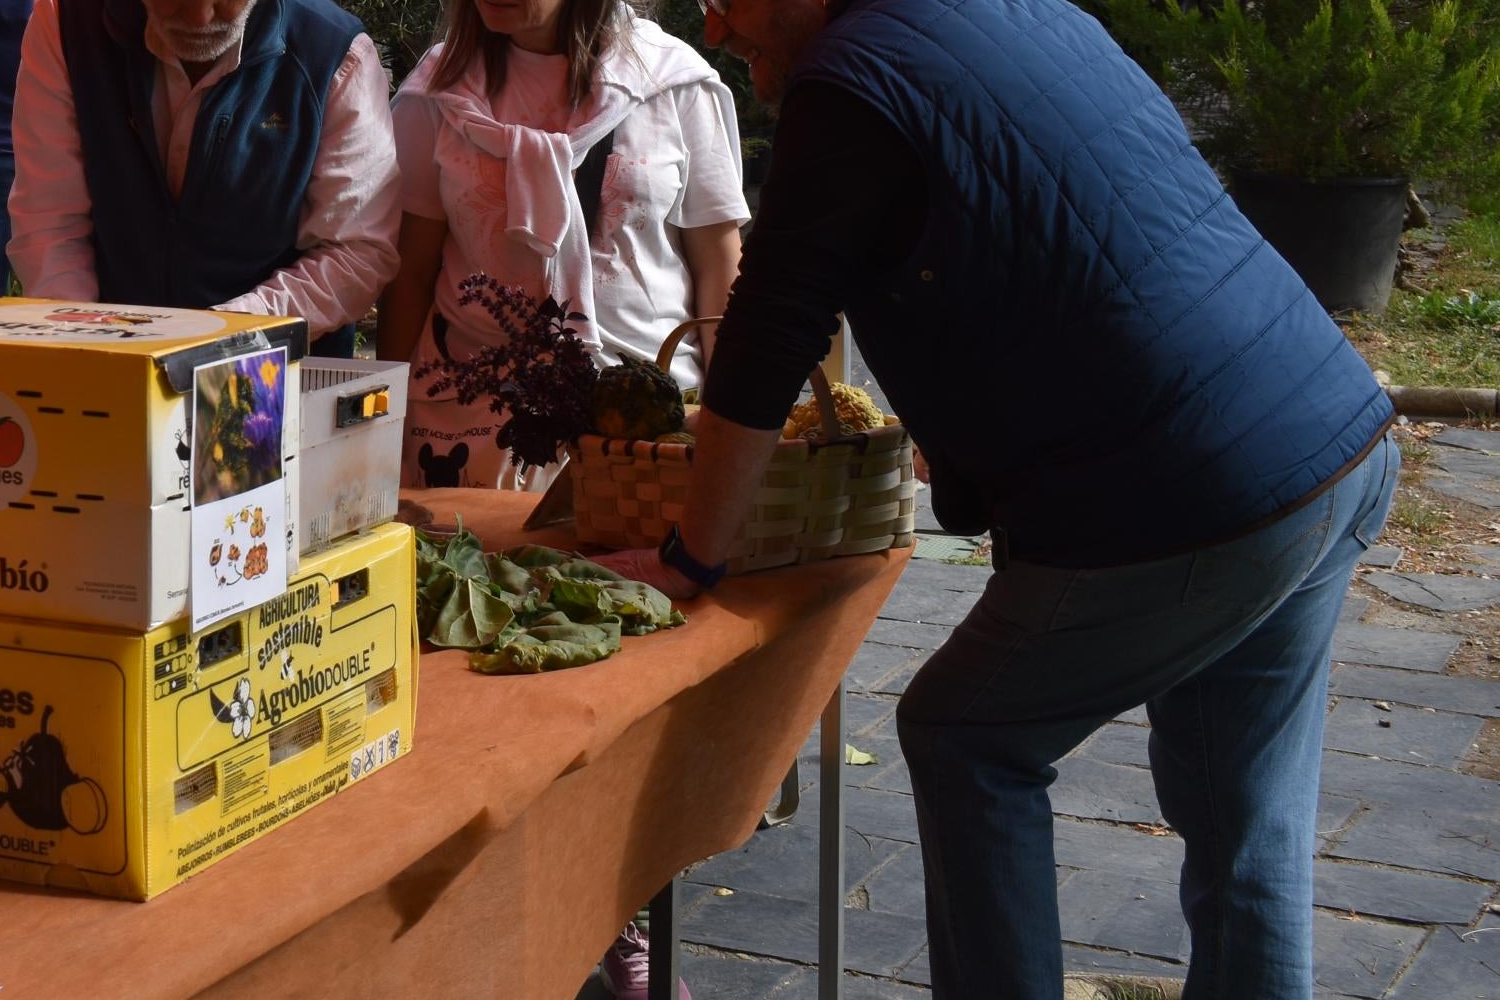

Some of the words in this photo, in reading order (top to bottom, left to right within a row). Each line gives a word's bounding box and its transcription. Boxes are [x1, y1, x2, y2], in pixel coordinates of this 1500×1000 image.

[429, 431, 454, 441] MOUSE
[259, 582, 320, 629] AGRICULTURA
[257, 615, 323, 670] sostenible
[177, 831, 216, 860] Polinización
[218, 825, 225, 838] de
[226, 813, 251, 833] cultivos
[312, 761, 349, 787] ornamentales
